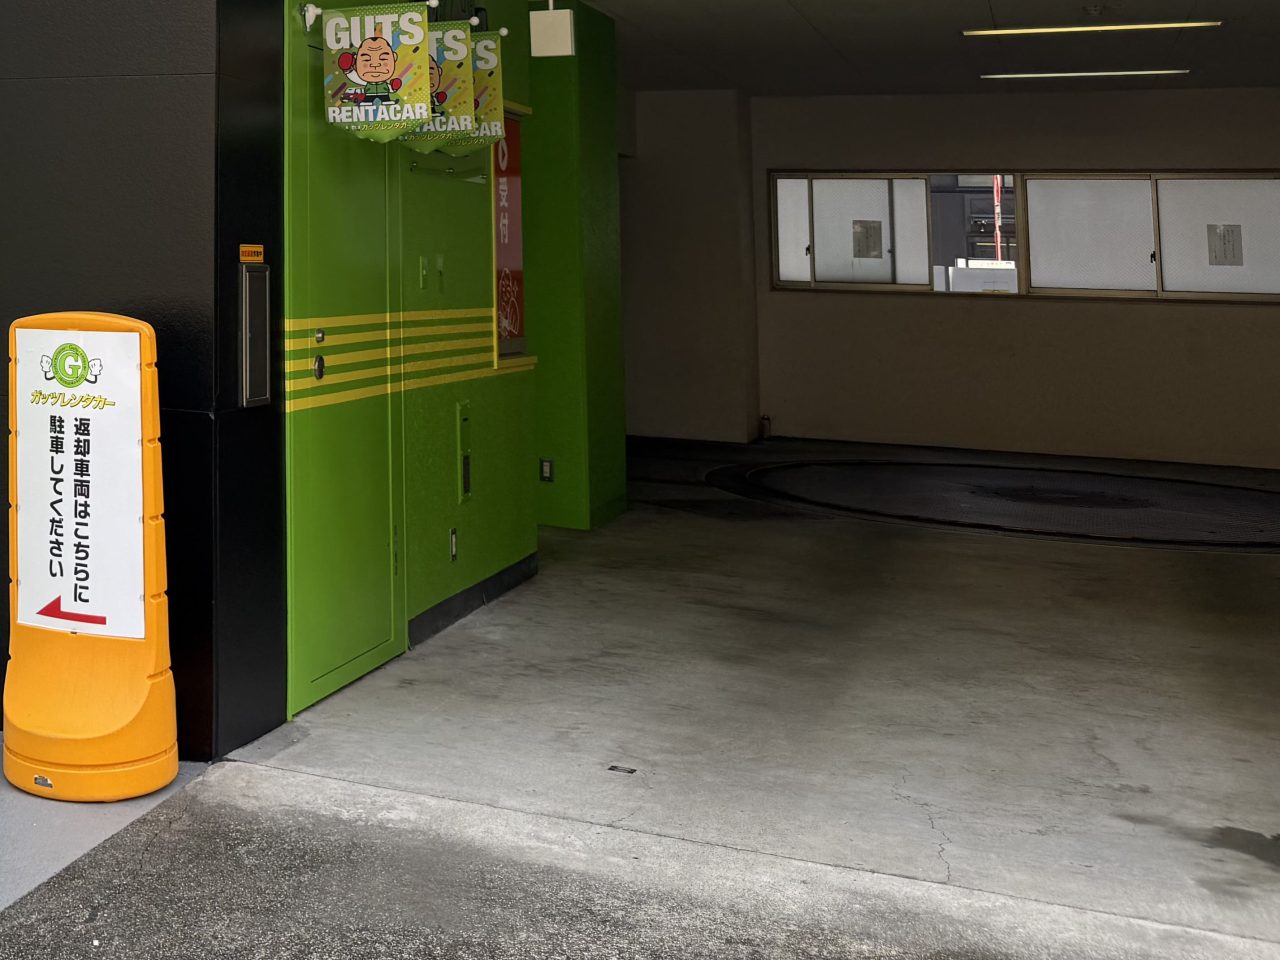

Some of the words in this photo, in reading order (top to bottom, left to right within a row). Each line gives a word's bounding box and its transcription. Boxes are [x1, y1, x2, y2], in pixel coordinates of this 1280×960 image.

[325, 11, 425, 51] GUTS
[428, 29, 468, 61] TS
[328, 103, 429, 123] RENTACAR
[31, 389, 116, 410] ガッツレンタカー
[48, 414, 65, 579] 駐車してください
[73, 416, 91, 604] 返却車両はこちらに
